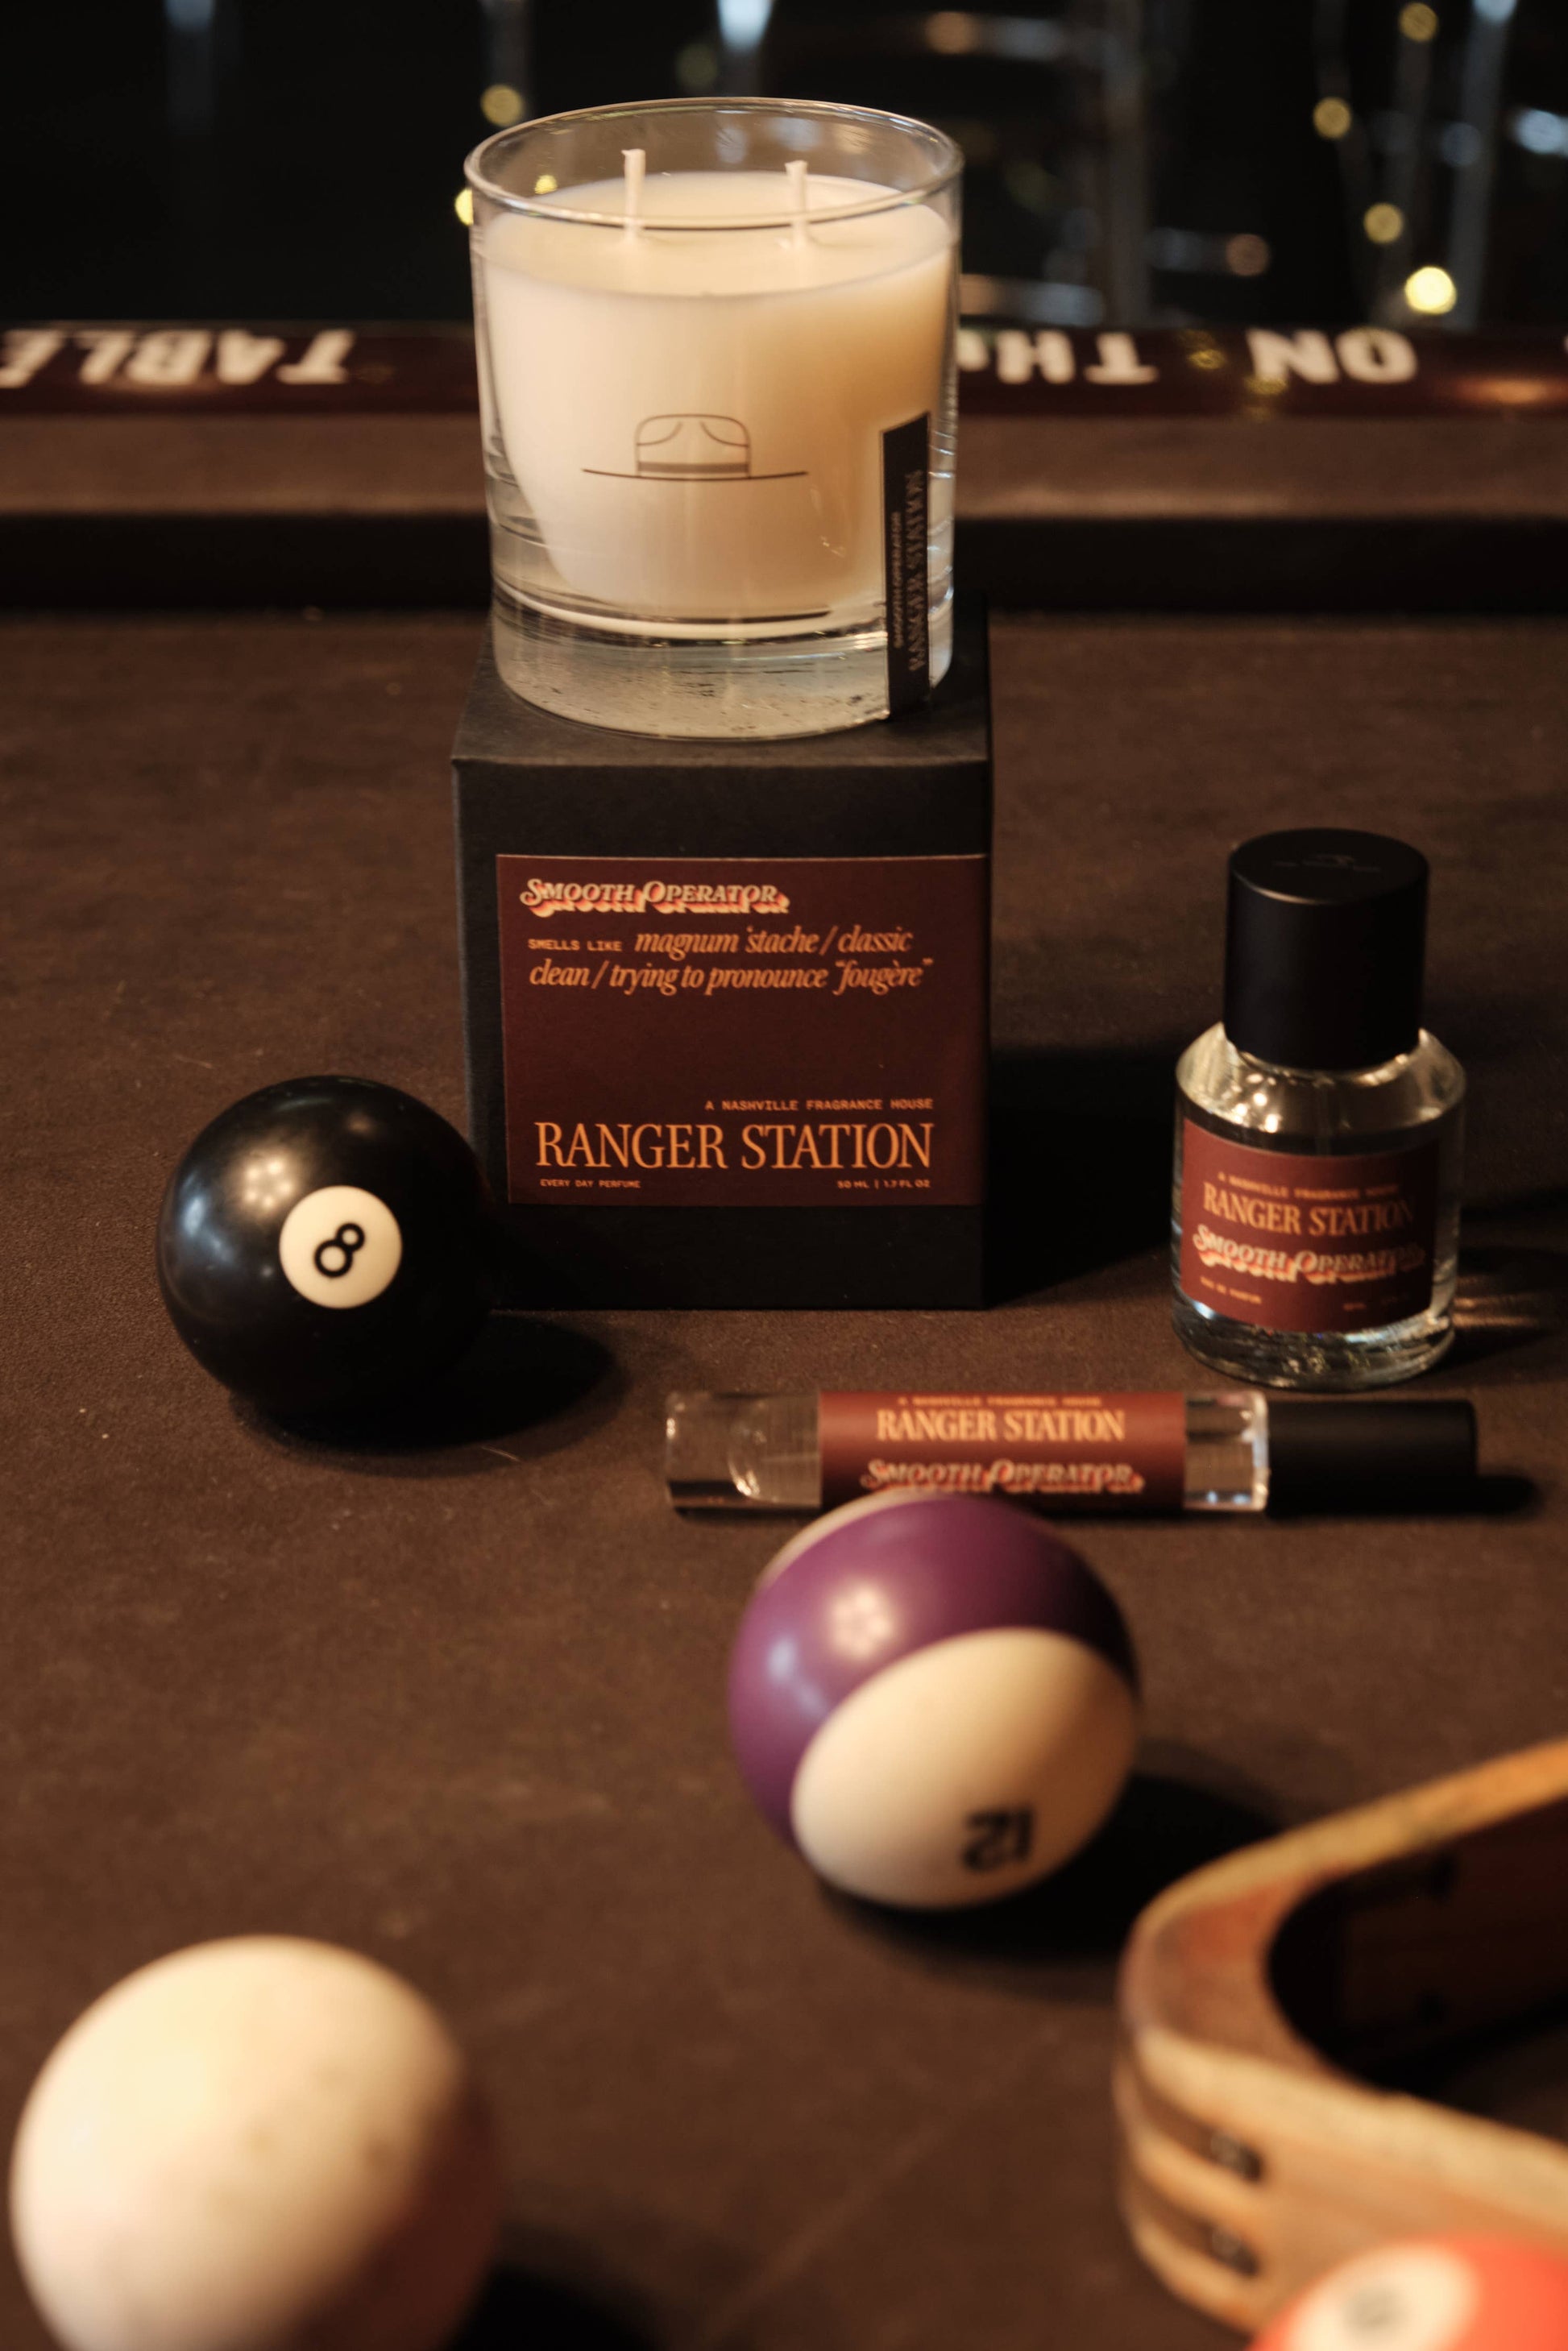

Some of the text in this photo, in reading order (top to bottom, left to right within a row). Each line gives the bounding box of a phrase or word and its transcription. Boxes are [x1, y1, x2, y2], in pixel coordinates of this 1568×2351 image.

[1246, 327, 1418, 384] ON
[519, 878, 790, 918] SMOOTH OPERATOR
[527, 939, 581, 952] SMELLS
[587, 940, 623, 952] LIKE
[634, 932, 740, 961] magnum
[837, 924, 914, 952] classic
[529, 958, 590, 985] clean
[608, 963, 680, 996] trying
[680, 965, 705, 988] to
[704, 967, 829, 996] pronounce
[704, 1097, 935, 1112] A NASHVILLE FRAGRANCE HOUSE
[535, 1122, 935, 1170] RANGER STATION
[539, 1178, 571, 1188] EVERY
[574, 1179, 595, 1188] DAY
[1203, 1182, 1301, 1236] RANGER
[1308, 1200, 1413, 1238] STATION
[313, 1221, 366, 1279] 8
[1193, 1223, 1298, 1283] SMOOTH
[876, 1408, 1126, 1441] RANGER STATION
[859, 1459, 1145, 1494] SMOOTH OPERATOR
